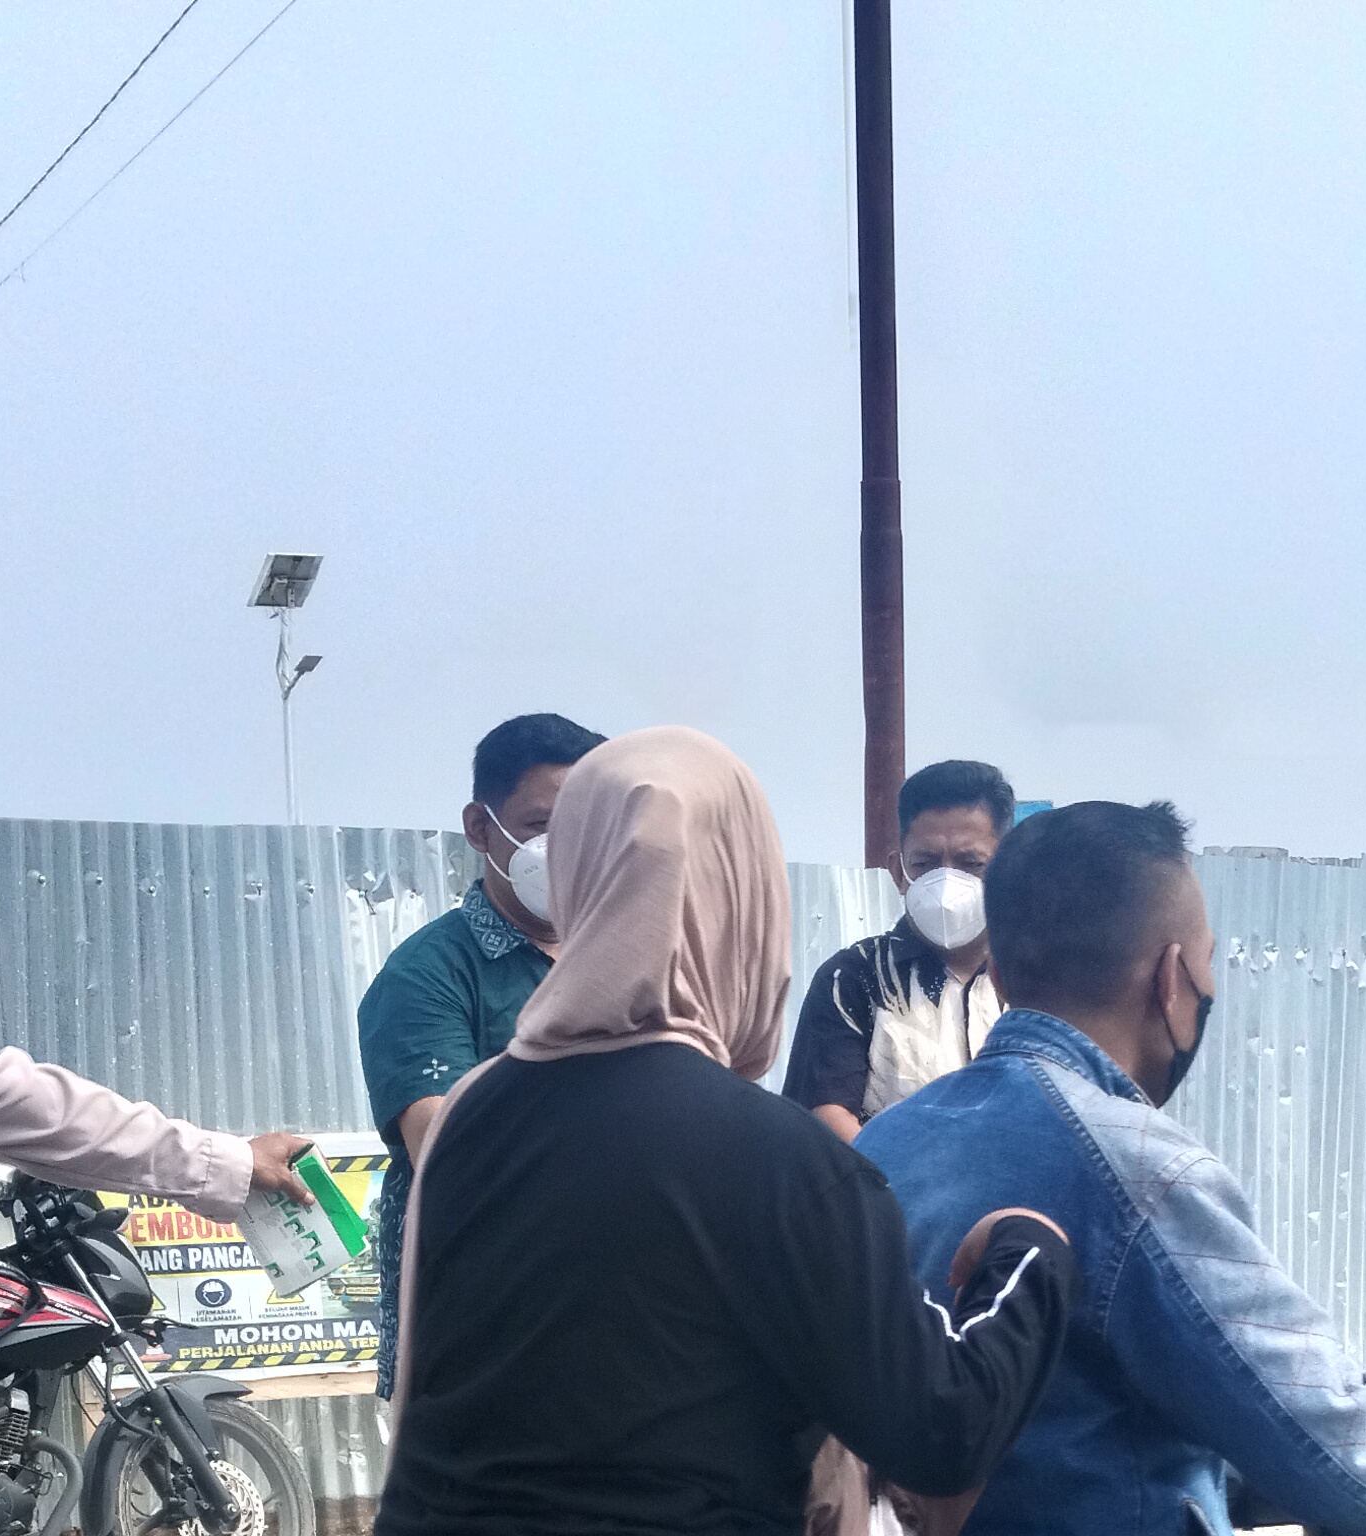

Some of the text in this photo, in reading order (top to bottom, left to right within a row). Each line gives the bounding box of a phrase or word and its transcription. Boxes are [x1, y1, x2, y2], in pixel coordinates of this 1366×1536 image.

[188, 1244, 261, 1270] PANCA
[214, 1322, 324, 1345] MOHON
[179, 1341, 294, 1359] PERJALANAN
[298, 1338, 346, 1352] ANDA
